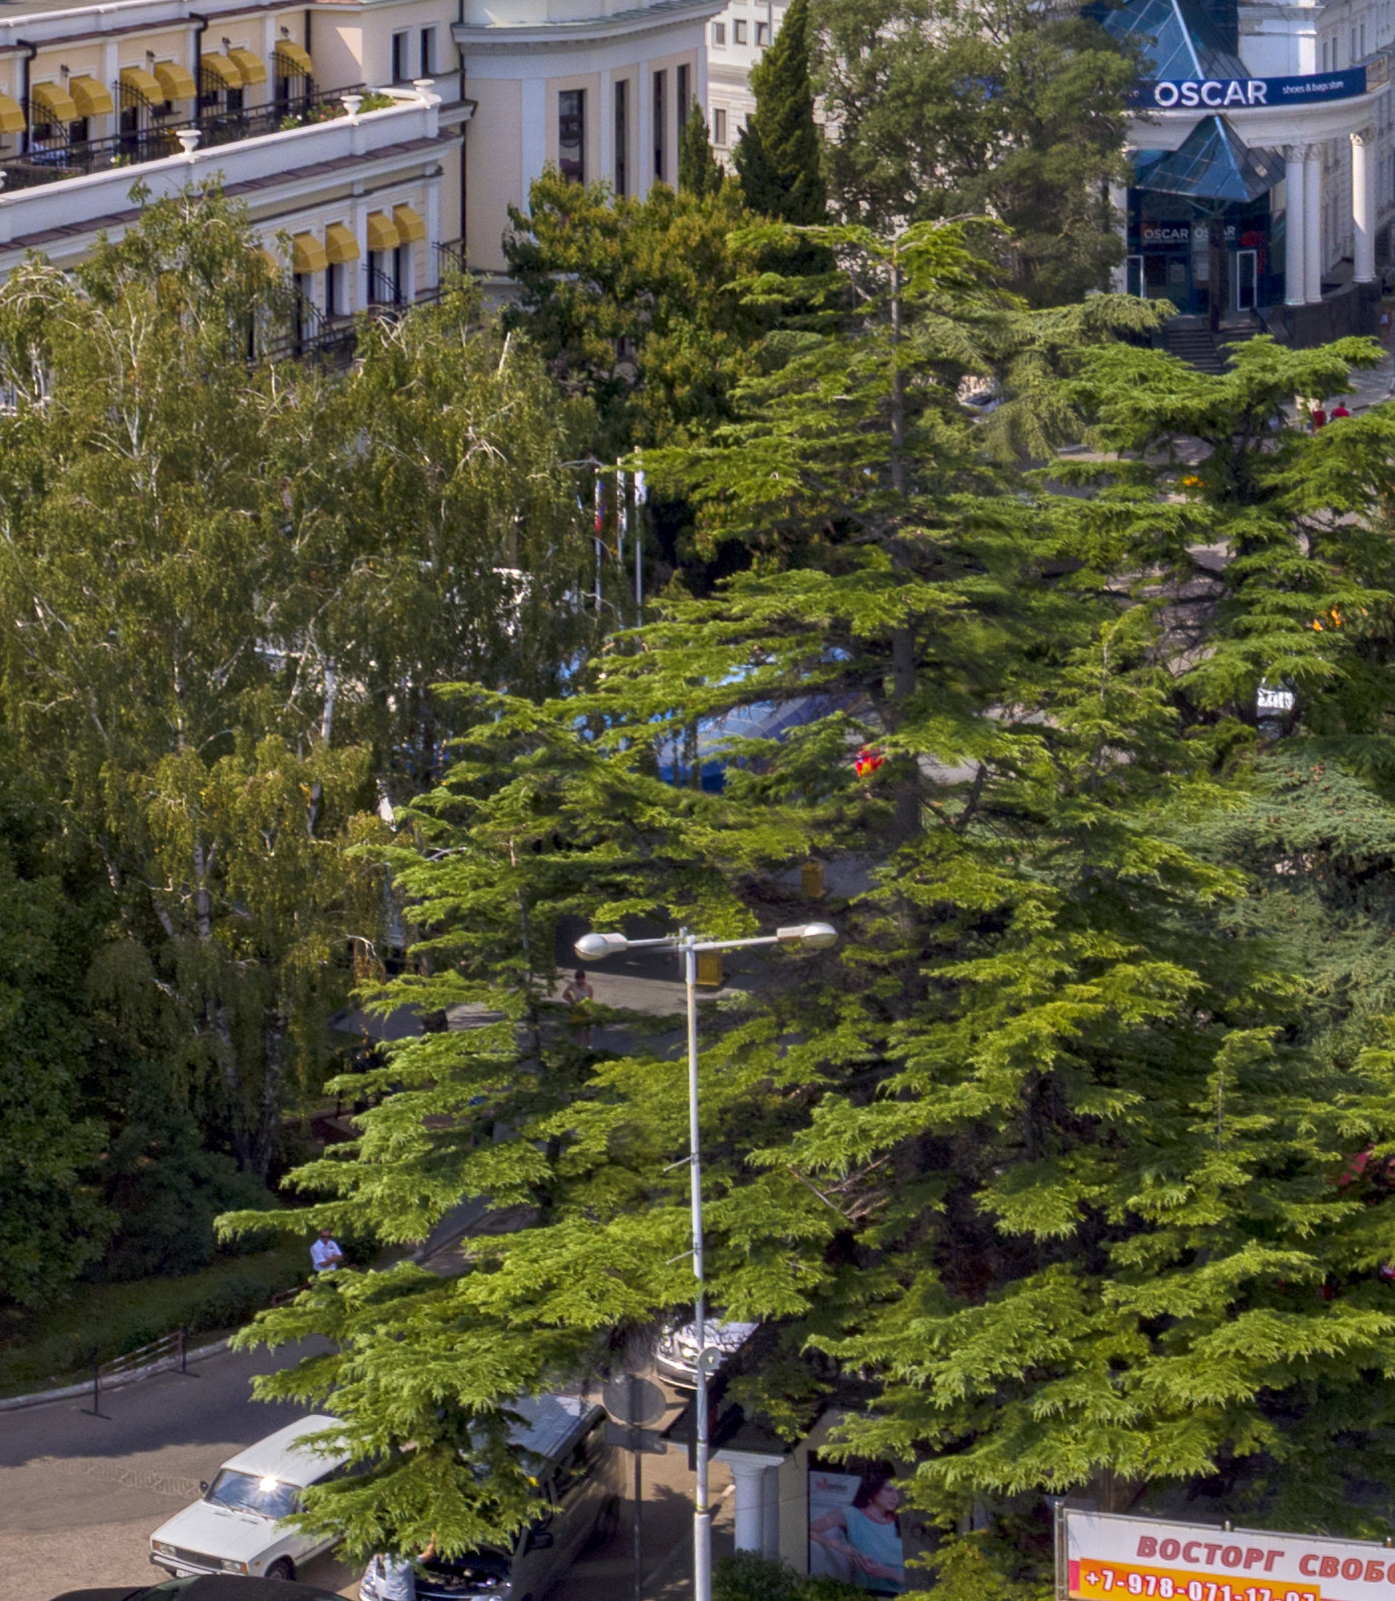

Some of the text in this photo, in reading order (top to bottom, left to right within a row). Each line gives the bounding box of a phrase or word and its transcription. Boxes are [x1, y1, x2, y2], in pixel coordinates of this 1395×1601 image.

[1154, 80, 1268, 107] OSCAR
[1282, 85, 1305, 95] shoes
[1311, 83, 1328, 93] bags
[1144, 228, 1189, 240] OSCAR
[1194, 225, 1236, 239] OSR
[1136, 1535, 1285, 1572] ВОСТОРГ
